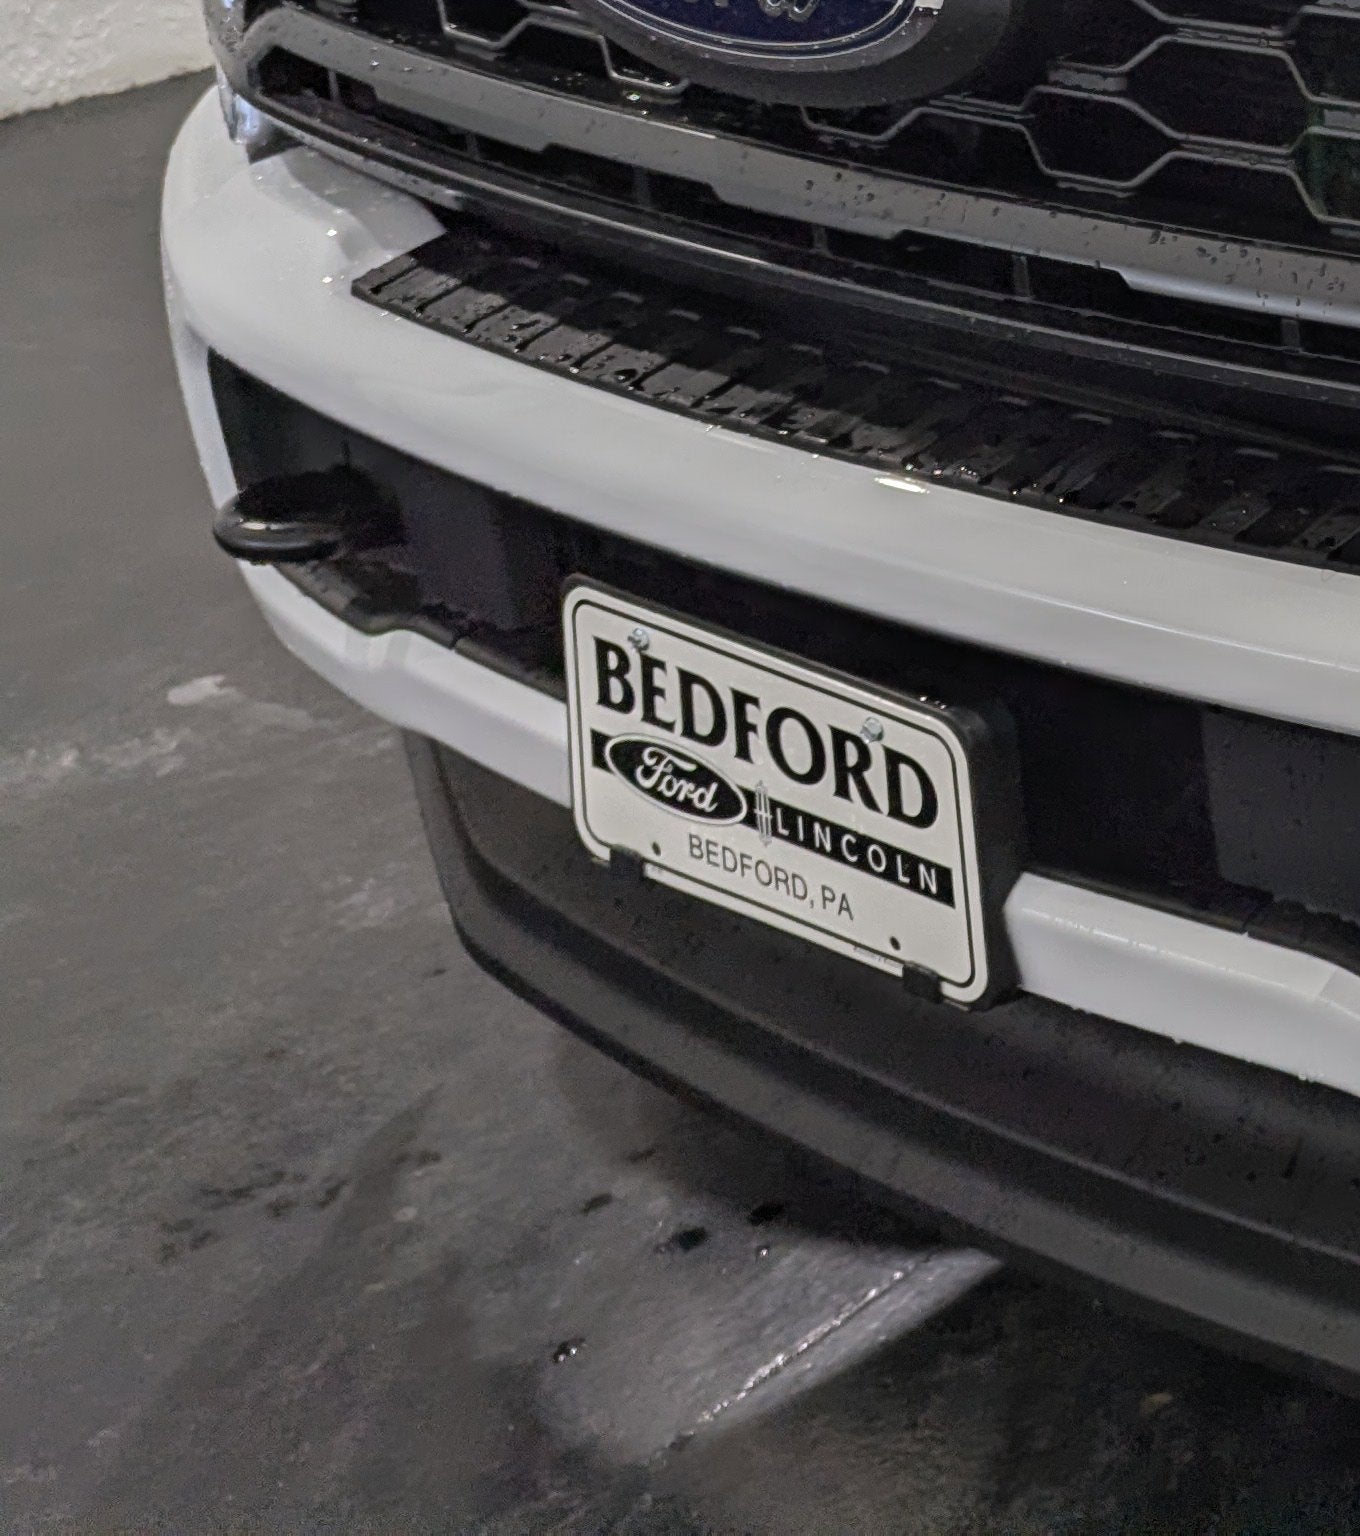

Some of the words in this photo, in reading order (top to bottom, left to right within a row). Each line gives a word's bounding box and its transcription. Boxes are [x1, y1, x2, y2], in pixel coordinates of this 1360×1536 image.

[593, 636, 939, 830] BEDFORD
[633, 745, 719, 814] Ford
[688, 832, 815, 910] BEDFORD,
[820, 884, 854, 921] PA
[774, 805, 938, 896] LINCOLN
